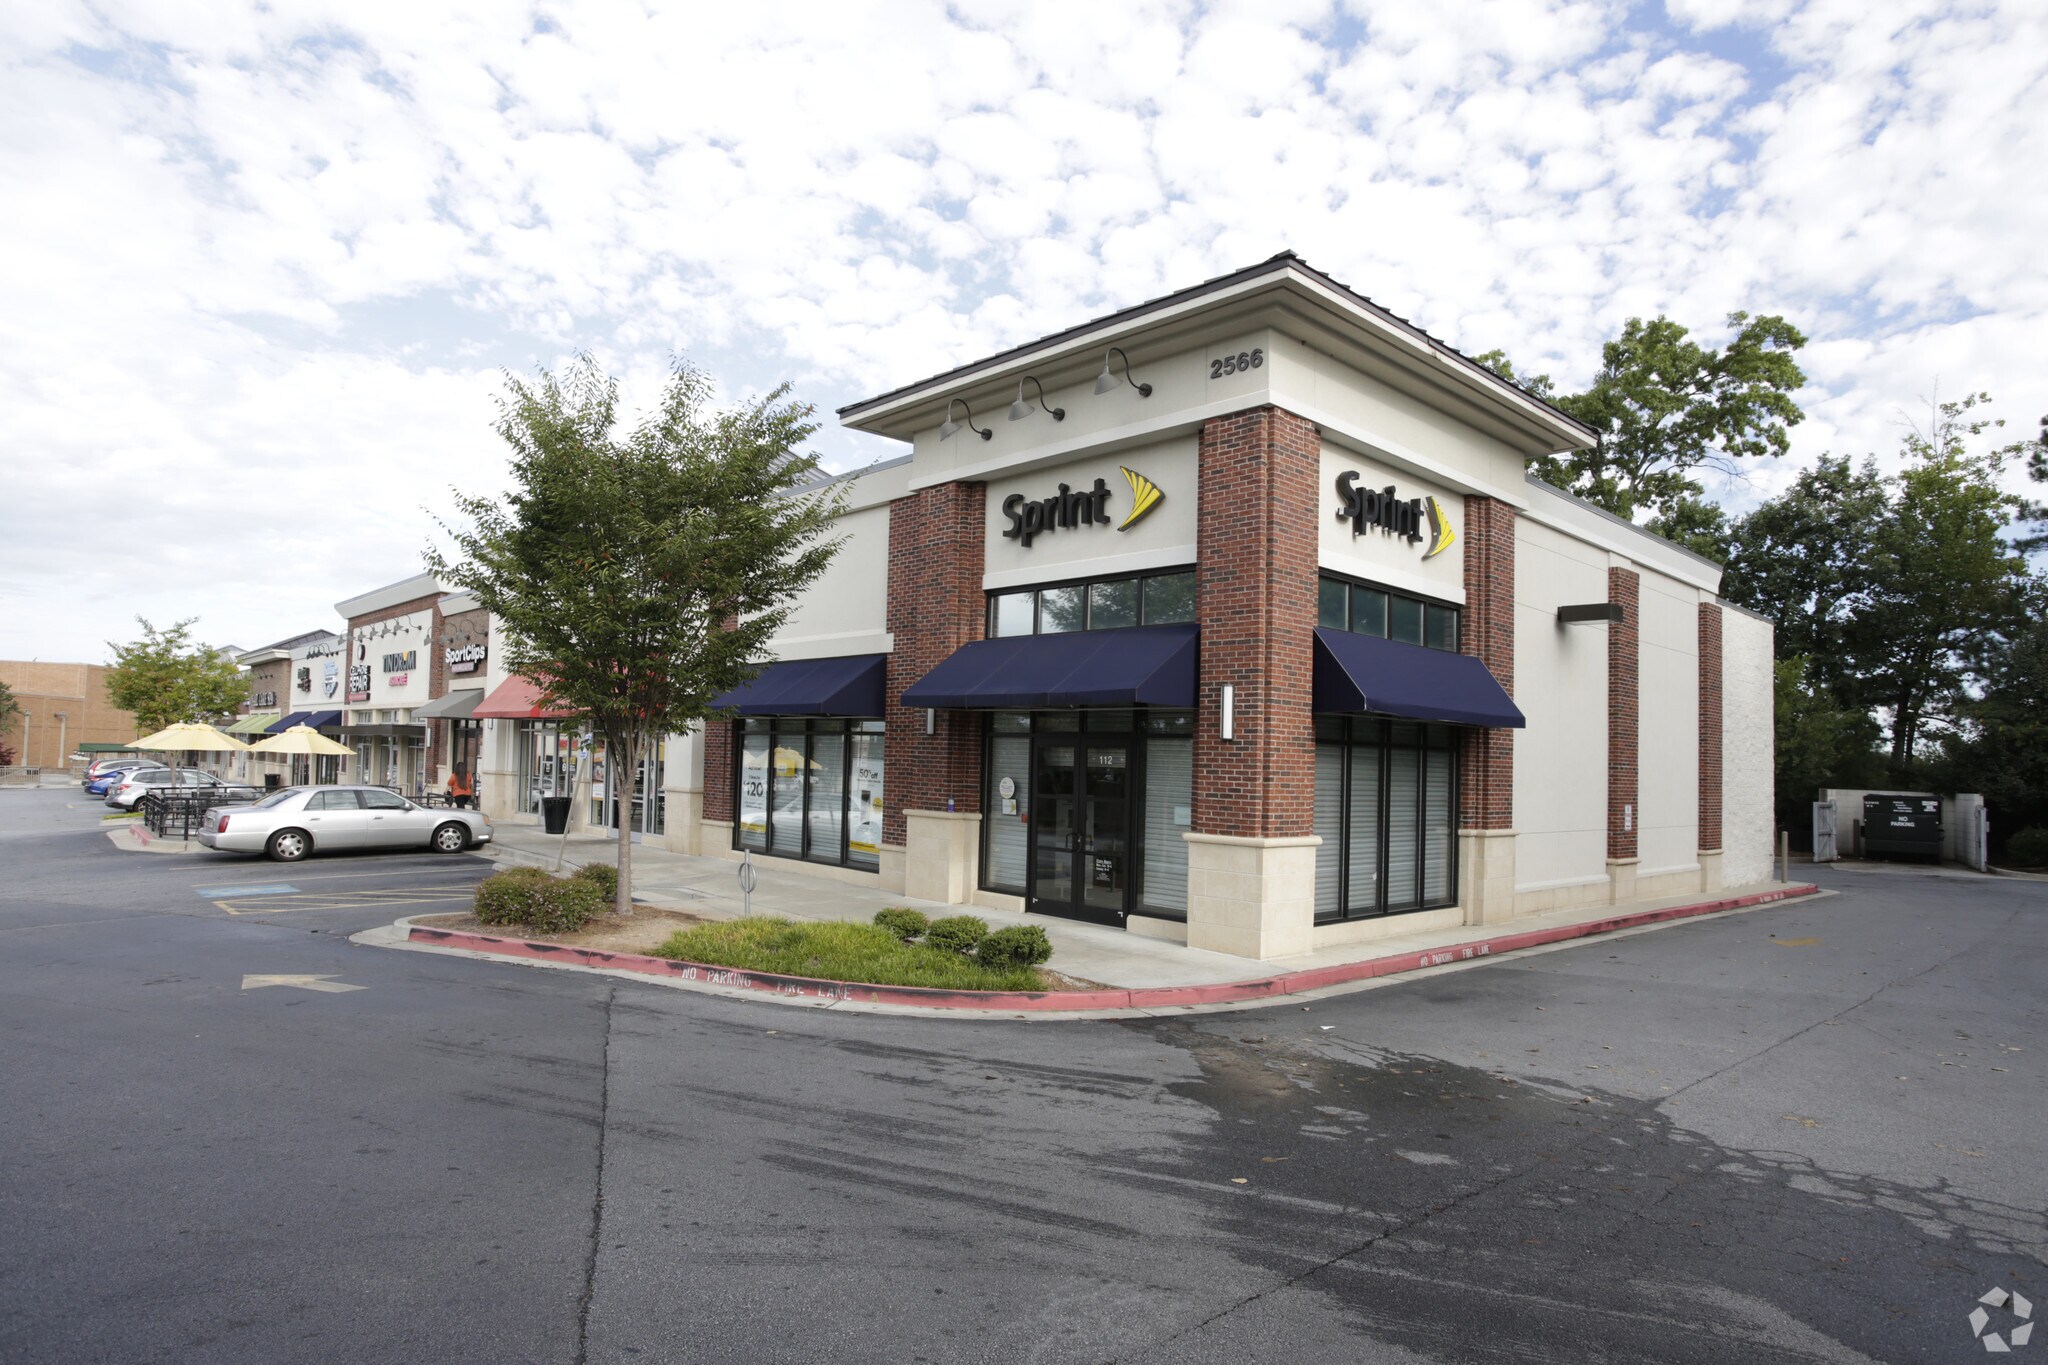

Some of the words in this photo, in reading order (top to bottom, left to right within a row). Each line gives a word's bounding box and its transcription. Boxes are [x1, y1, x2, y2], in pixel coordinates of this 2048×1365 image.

[1210, 348, 1263, 379] 2566
[1002, 477, 1111, 548] Sprint
[1335, 470, 1424, 543] Sprint
[1099, 756, 1112, 765] 112
[1420, 956, 1428, 967] NO
[1432, 952, 1453, 965] PARKING
[1462, 947, 1473, 959] FIRE
[1477, 944, 1490, 955] LANE
[681, 967, 697, 980] NO
[706, 969, 752, 987] PARKING
[818, 984, 853, 1001] LANE
